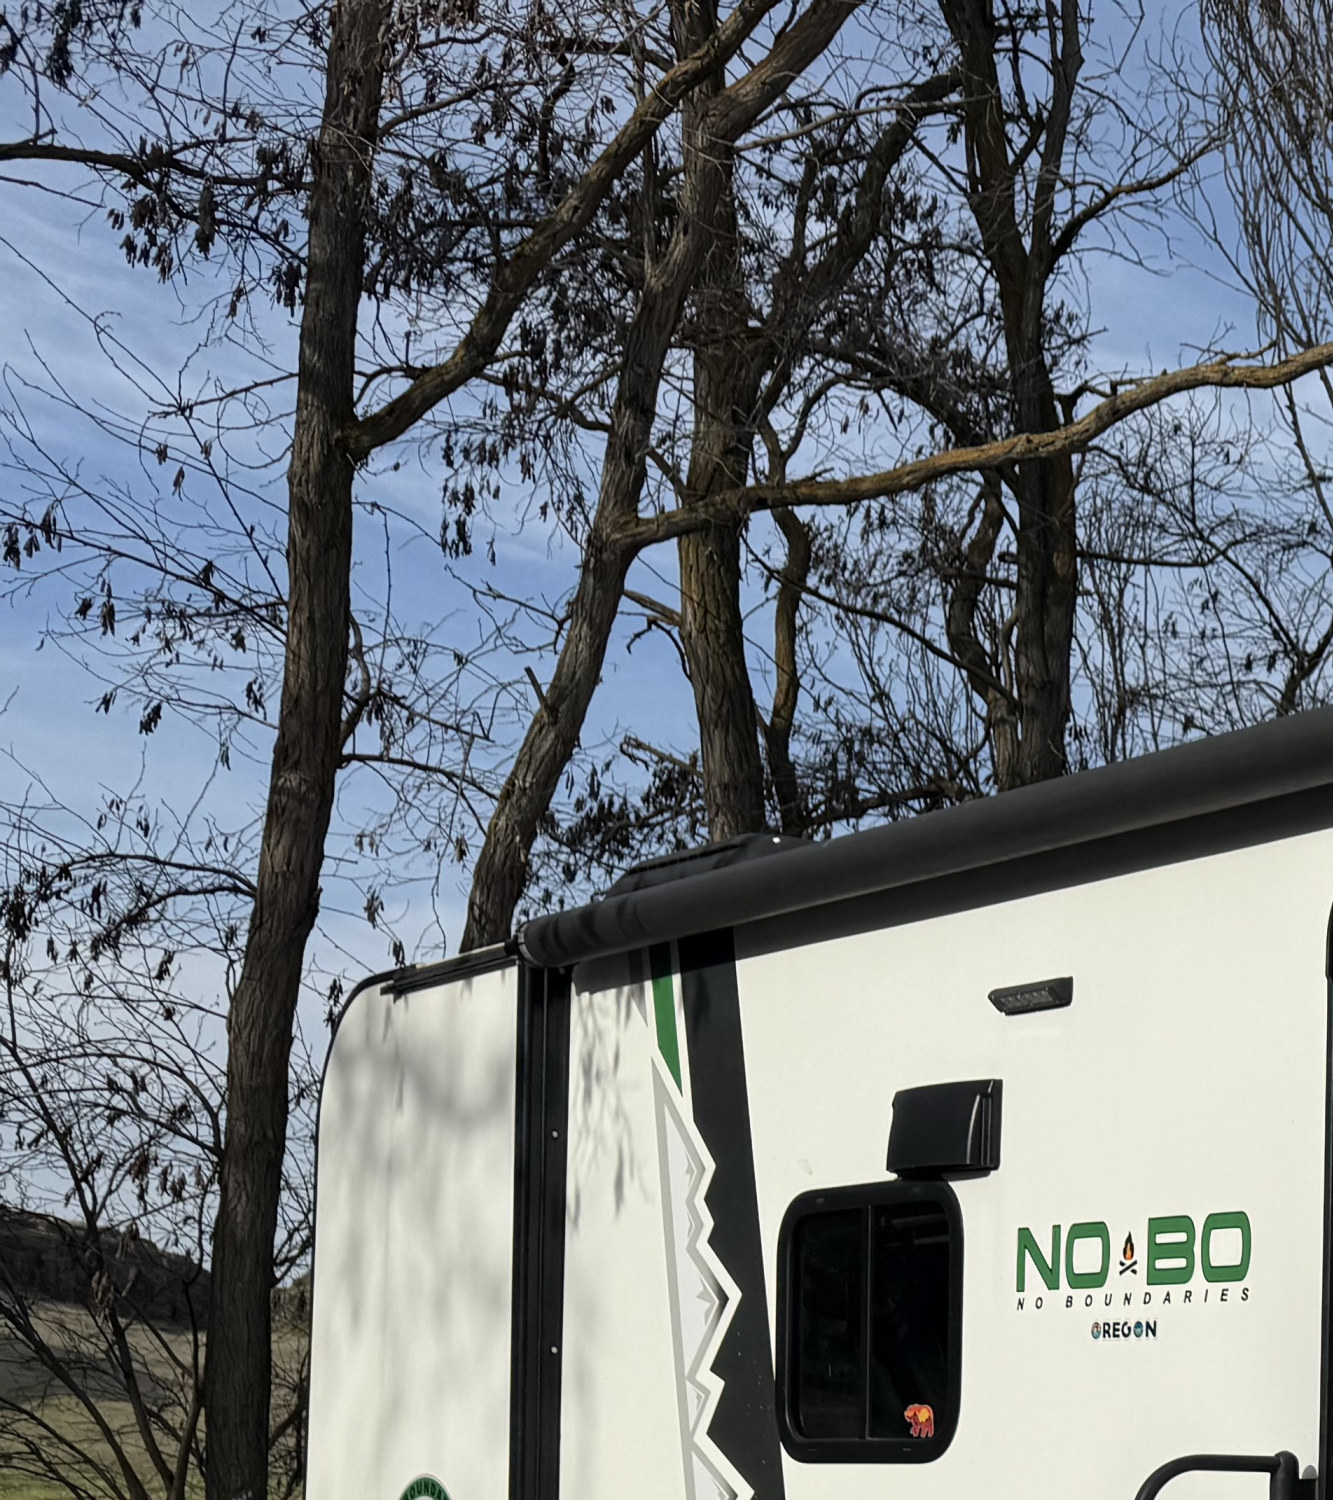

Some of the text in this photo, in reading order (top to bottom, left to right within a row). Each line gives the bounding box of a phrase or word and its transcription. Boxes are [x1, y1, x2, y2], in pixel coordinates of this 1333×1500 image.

[1016, 1211, 1252, 1292] NO BO
[1016, 1287, 1250, 1311] NO BOUNDARIES
[1091, 1320, 1157, 1340] OREGON
